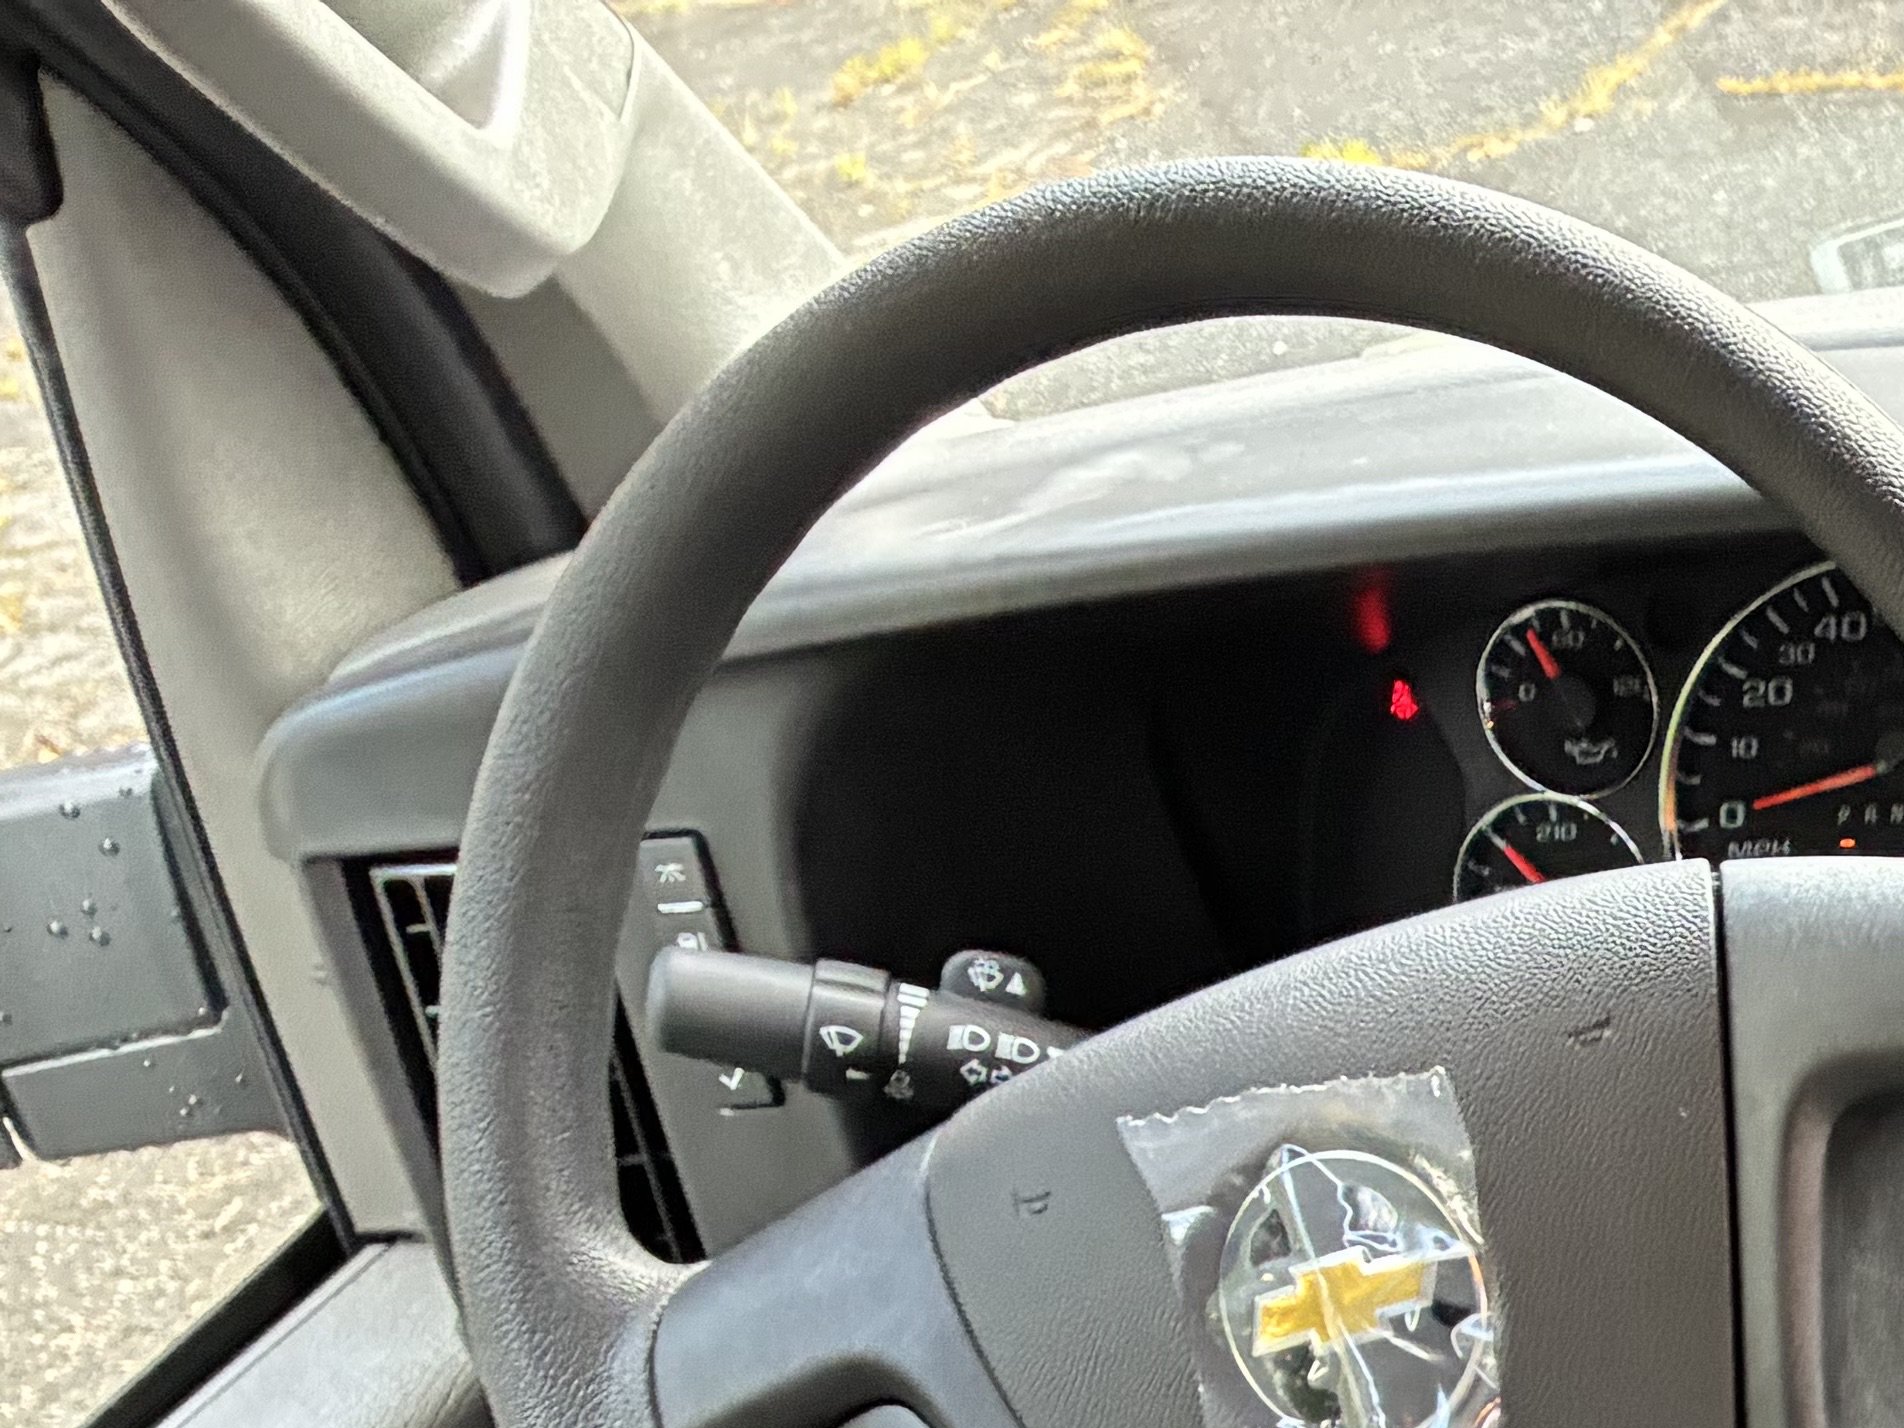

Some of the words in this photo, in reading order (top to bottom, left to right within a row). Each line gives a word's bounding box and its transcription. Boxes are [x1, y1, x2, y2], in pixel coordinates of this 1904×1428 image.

[1814, 611, 1867, 641] 40
[1778, 642, 1815, 666] 30
[1519, 684, 1535, 701] 0
[1742, 676, 1794, 708] 20
[1731, 736, 1759, 760] 10
[1719, 802, 1746, 829] 0
